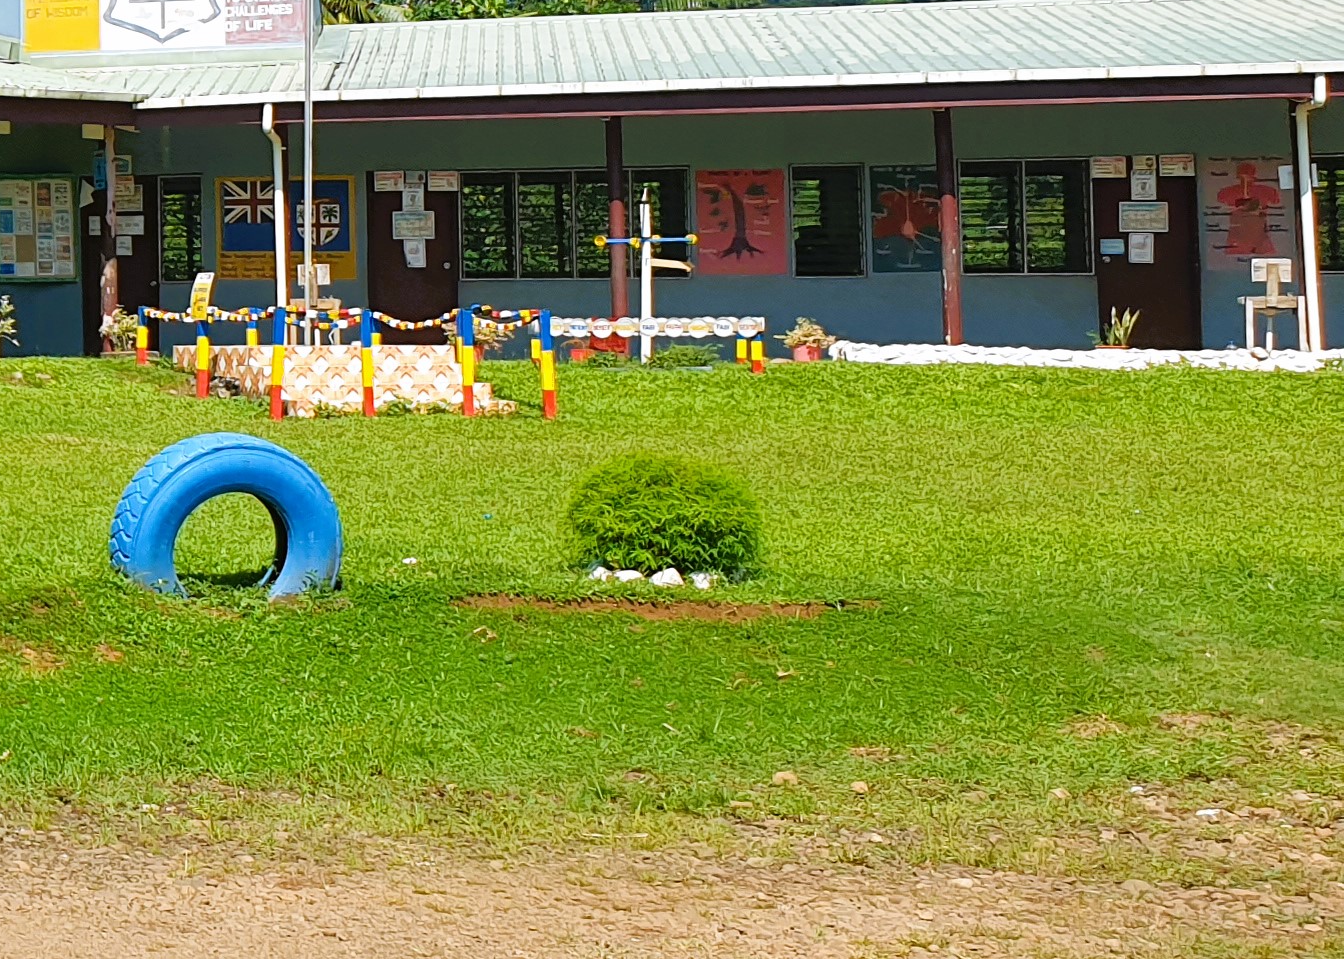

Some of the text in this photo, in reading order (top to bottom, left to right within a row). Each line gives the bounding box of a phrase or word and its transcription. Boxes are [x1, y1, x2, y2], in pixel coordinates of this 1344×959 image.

[26, 6, 88, 19] OF WISDOM
[225, 4, 293, 17] CHALLENGES
[225, 19, 272, 32] OF LIFE
